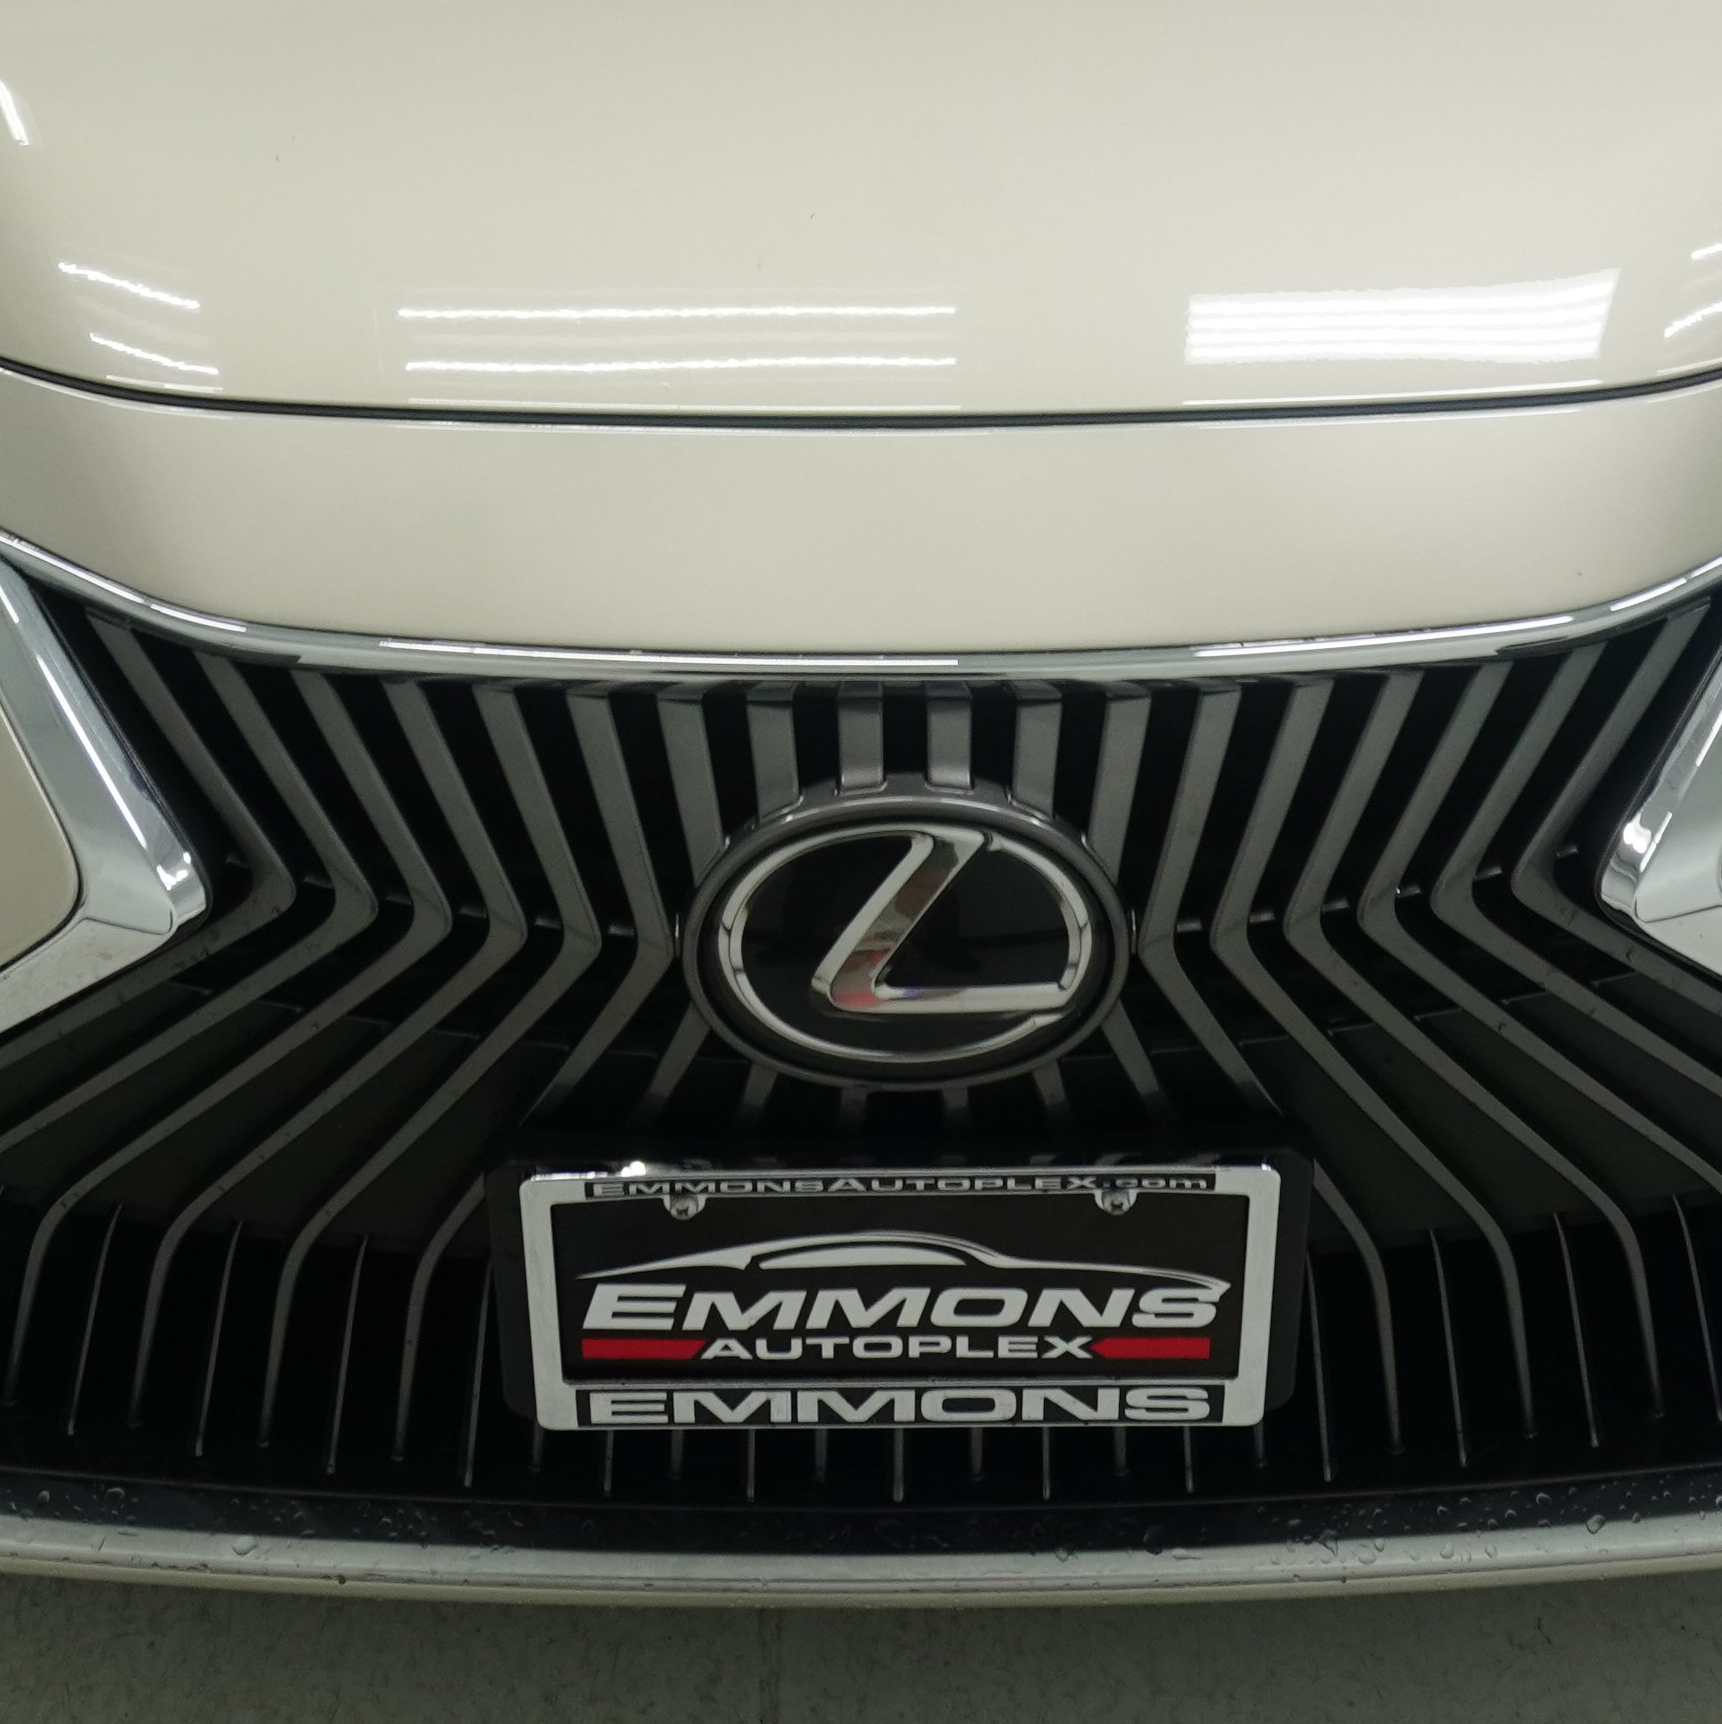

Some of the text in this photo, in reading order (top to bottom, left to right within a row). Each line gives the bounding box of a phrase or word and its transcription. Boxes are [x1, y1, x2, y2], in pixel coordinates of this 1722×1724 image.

[582, 1283, 1219, 1330] EMMONS
[700, 1335, 1093, 1359] AUTOPLEX
[589, 1387, 1210, 1424] EMMONS
